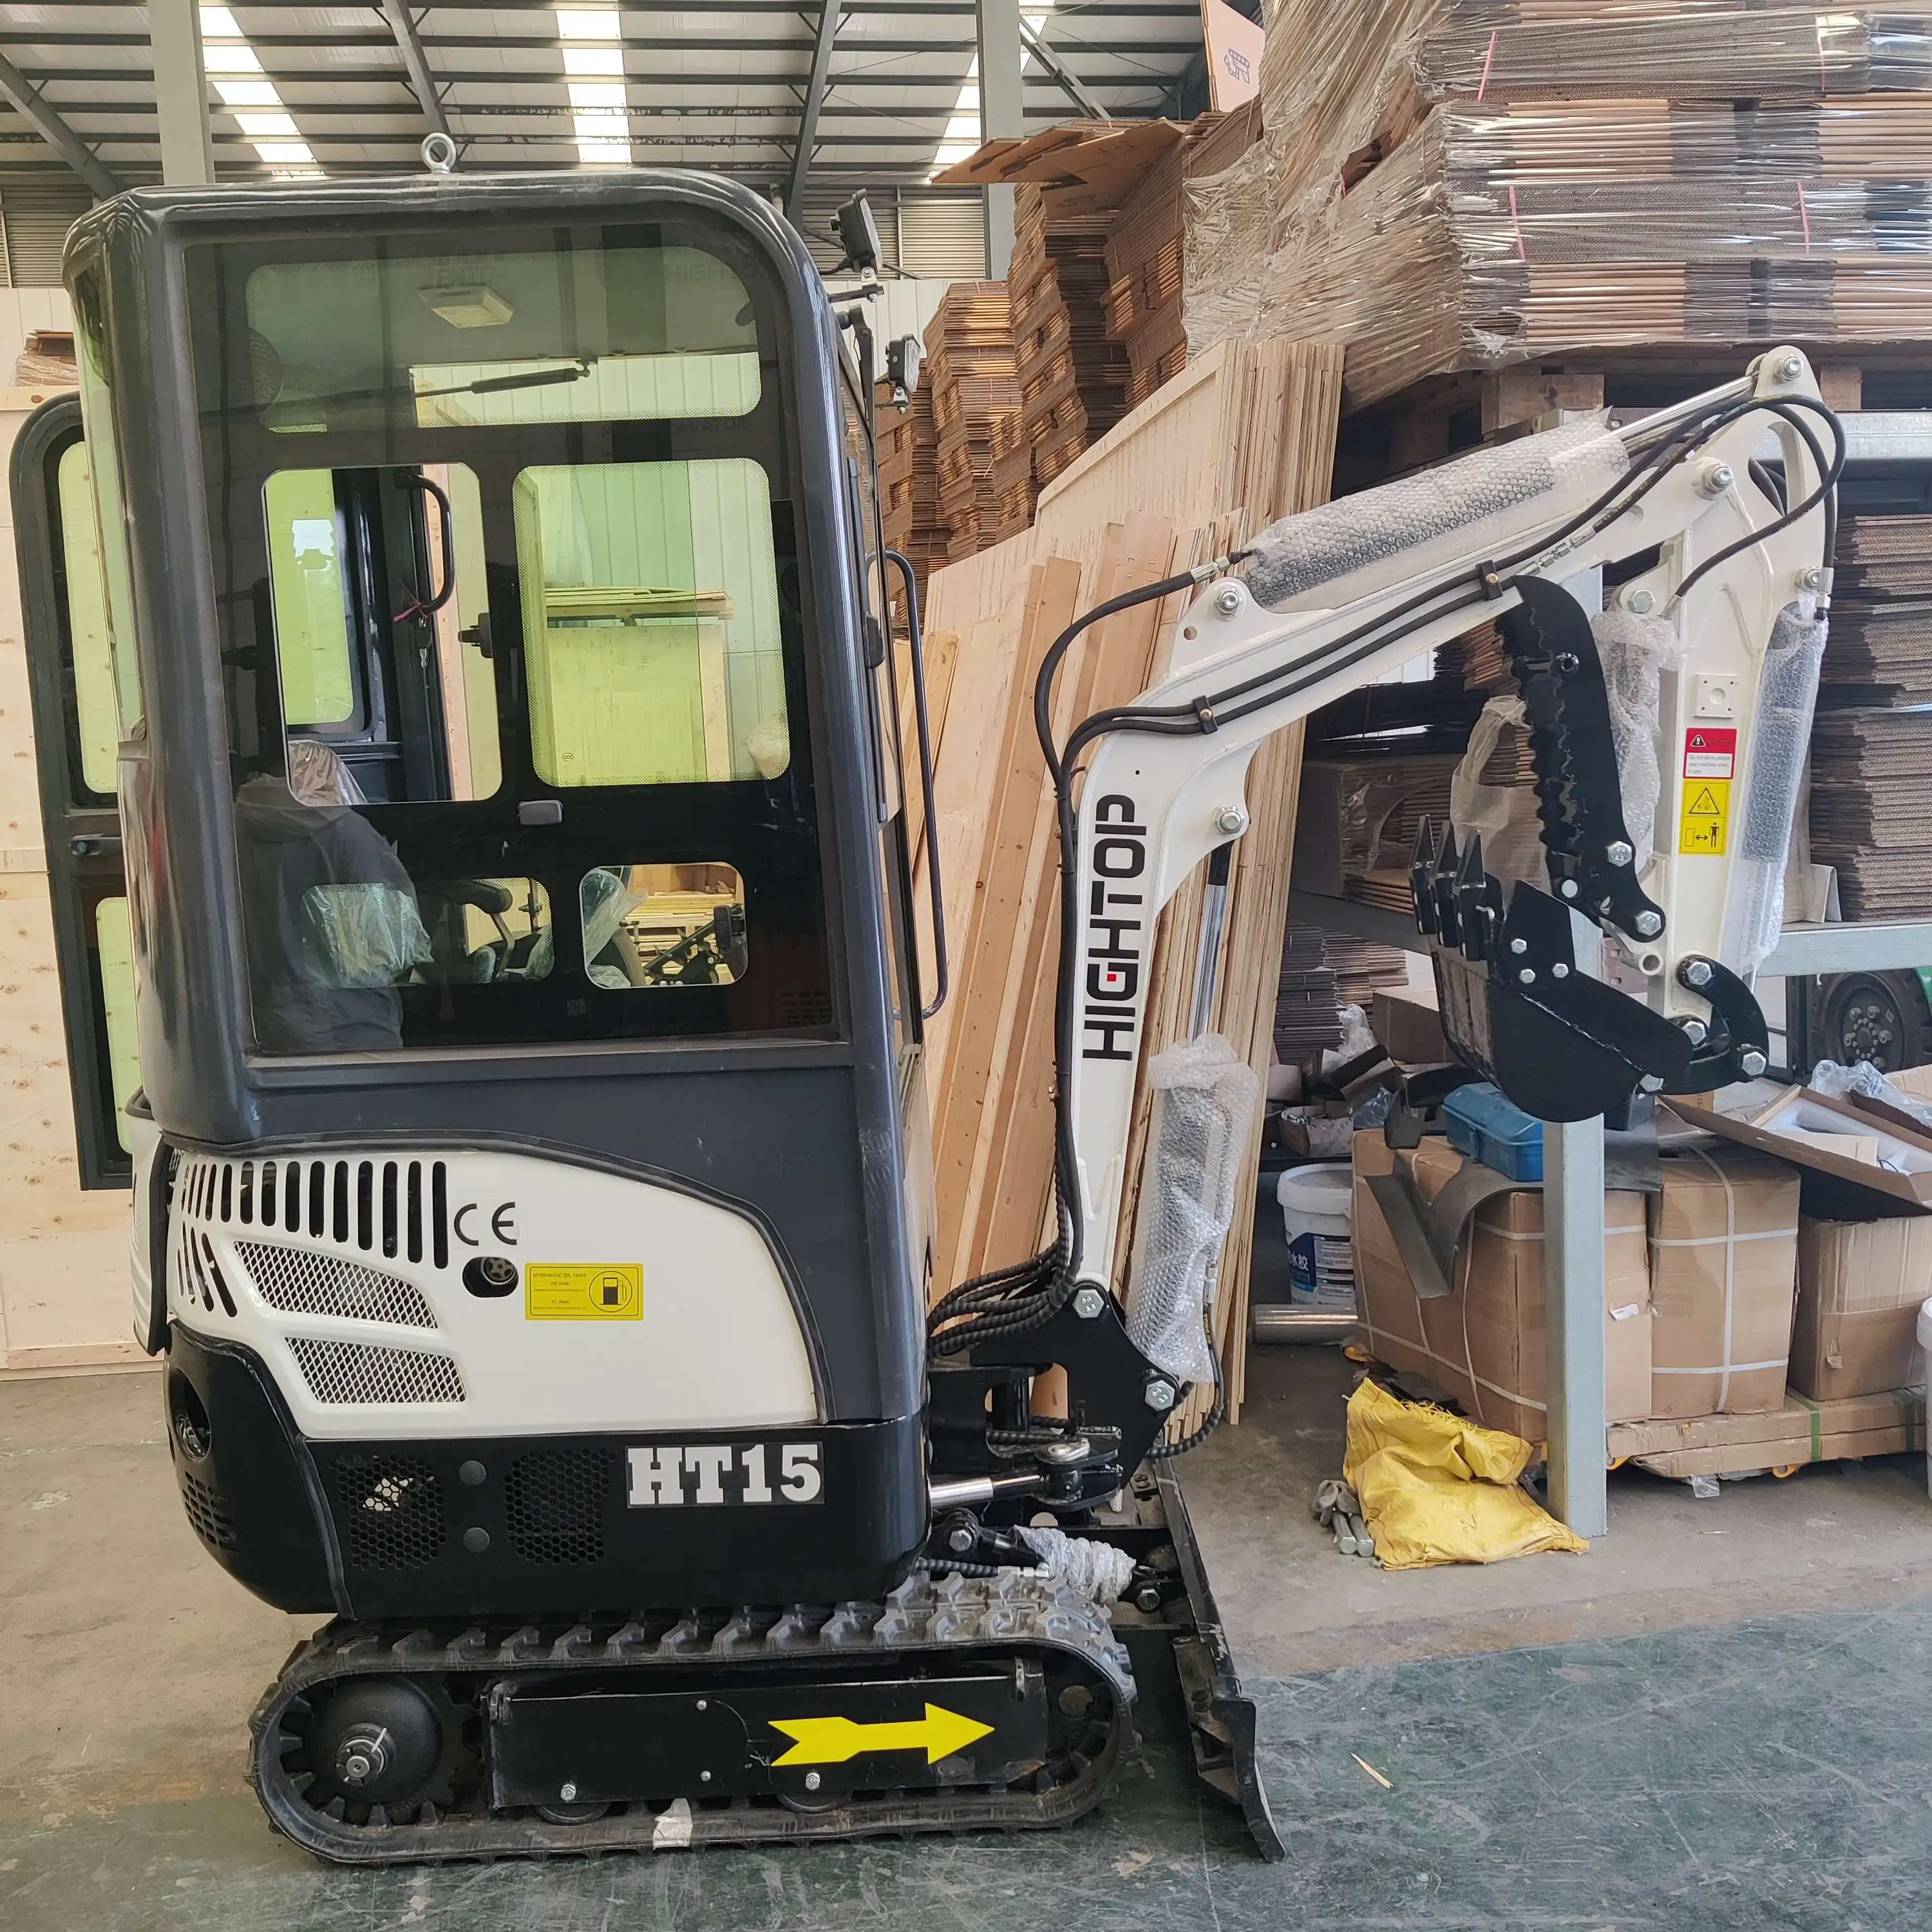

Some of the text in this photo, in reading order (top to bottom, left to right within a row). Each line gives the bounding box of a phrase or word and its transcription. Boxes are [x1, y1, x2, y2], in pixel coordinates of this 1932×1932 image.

[1082, 794, 1147, 1061] HIGHTOP
[454, 1202, 517, 1246] CE
[628, 1444, 821, 1504] HT15
